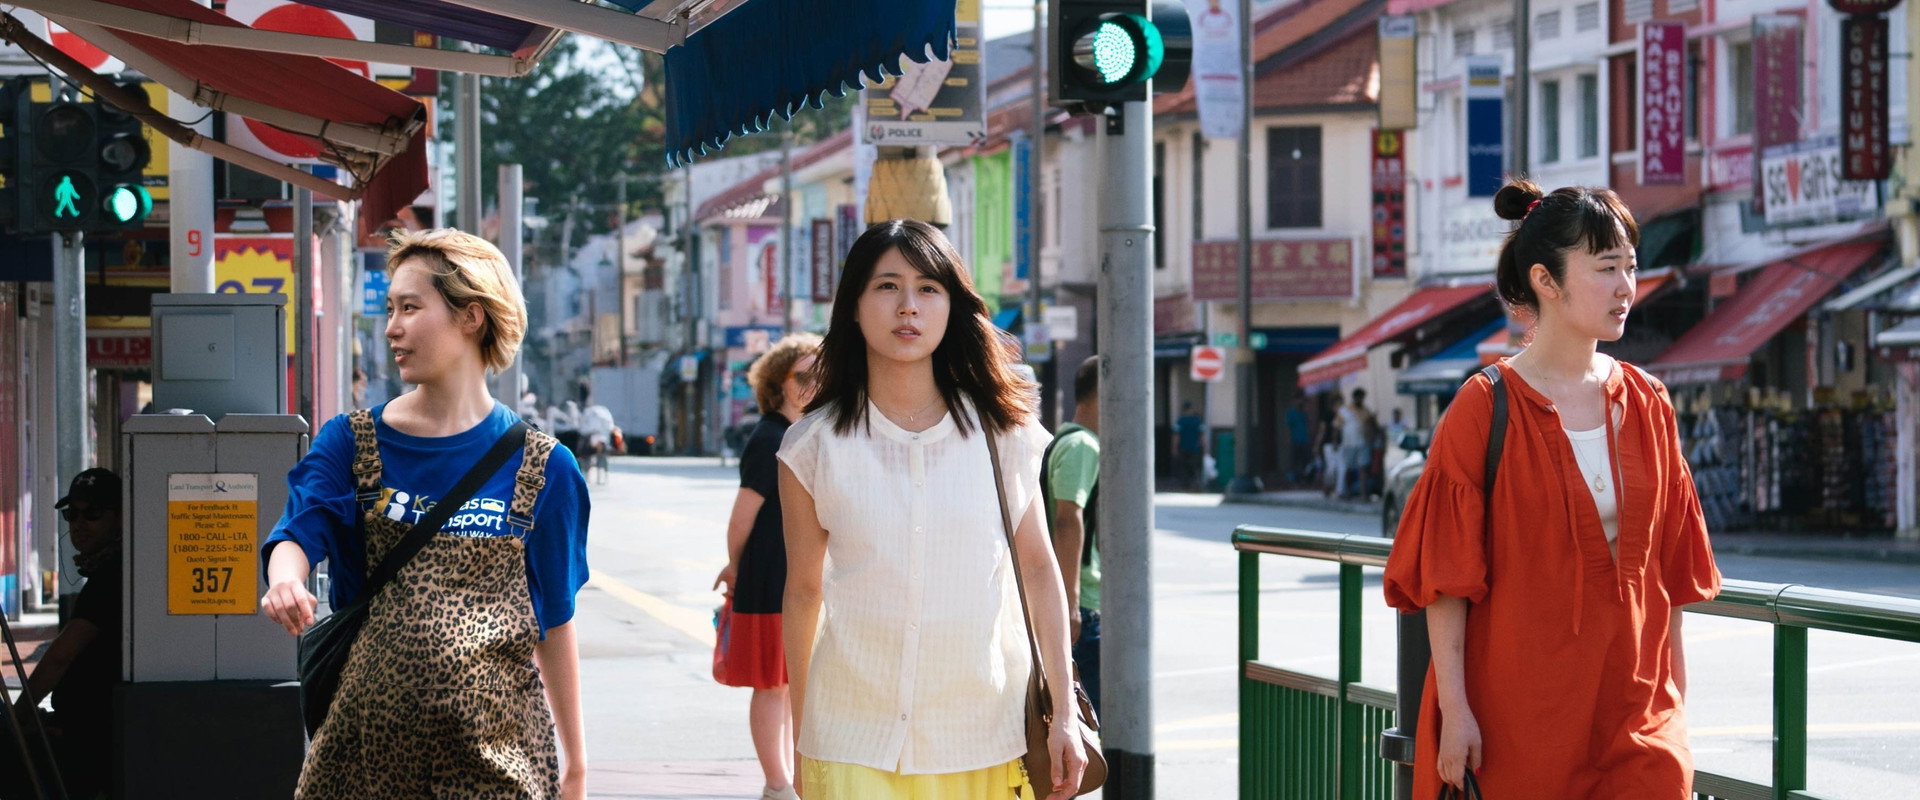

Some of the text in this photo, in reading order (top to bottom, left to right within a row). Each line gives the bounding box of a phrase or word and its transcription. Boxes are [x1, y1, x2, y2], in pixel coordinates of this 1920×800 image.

[1646, 26, 1664, 172] NAKSHATRA
[1666, 49, 1681, 149] BEAUTY
[1849, 23, 1866, 174] COSTUME
[1868, 25, 1884, 172] JEWELLERY
[888, 129, 923, 137] POLICE
[1768, 164, 1788, 206] SG
[1801, 154, 1831, 202] Gift
[187, 229, 202, 257] 9
[186, 483, 213, 492] Transport
[227, 484, 255, 492] Authority
[188, 503, 199, 511] For
[201, 503, 230, 511] Feedback
[412, 494, 480, 513] Kaas
[170, 512, 191, 520] Traffic
[192, 513, 212, 521] Signal
[195, 522, 215, 530] Please
[208, 556, 227, 564] Signal
[192, 567, 234, 593] 357
[190, 597, 237, 606] www.lta.gov.sg
